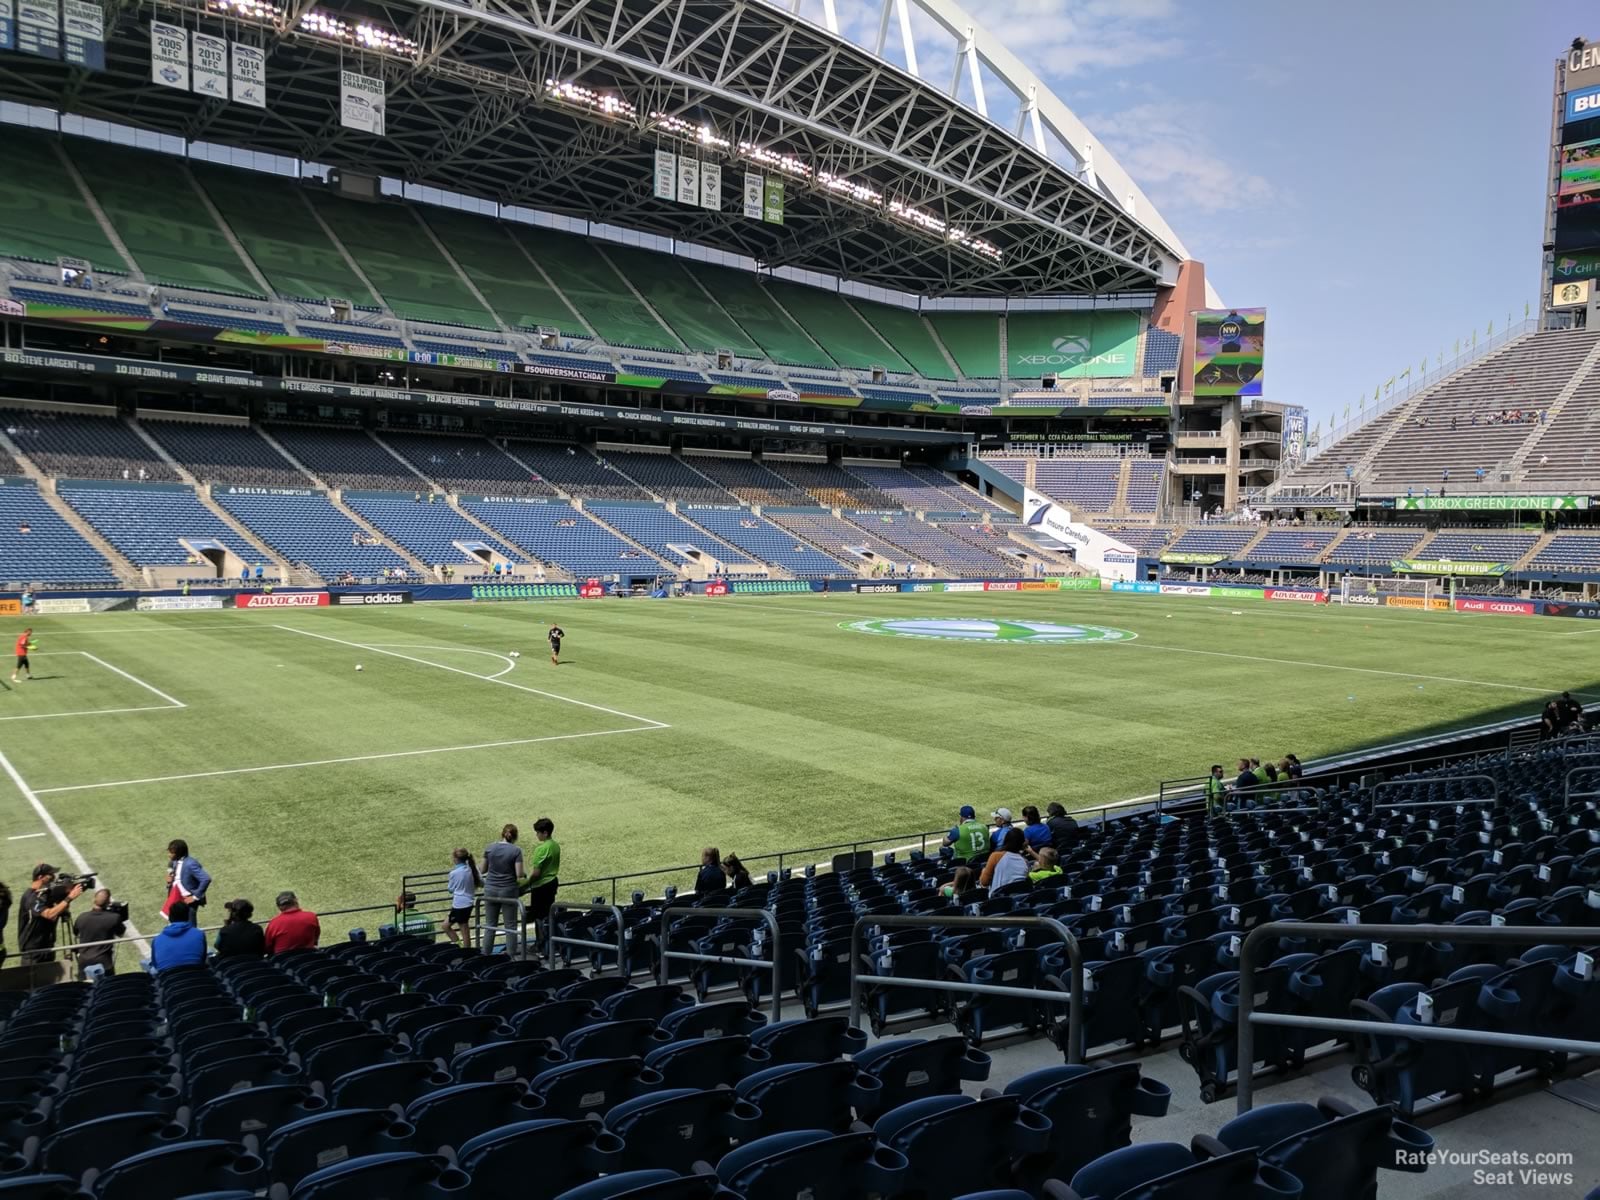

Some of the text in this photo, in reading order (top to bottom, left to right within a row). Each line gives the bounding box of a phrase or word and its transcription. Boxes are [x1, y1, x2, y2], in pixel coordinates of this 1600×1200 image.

[157, 37, 182, 51] 2005
[161, 48, 179, 59] NFC
[198, 48, 222, 62] 2013
[201, 59, 219, 69] NFC
[237, 58, 260, 72] 2014
[240, 68, 257, 79] NFC
[343, 72, 383, 89] 2013 WORLD
[343, 80, 384, 95] CHAMPIONS
[1575, 262, 1592, 274] CHI
[1223, 326, 1237, 334] NW
[20, 355, 44, 367] STEVE
[45, 357, 78, 369] LARGENT
[348, 345, 383, 357] SOUNDERS
[383, 350, 393, 359] FC
[398, 351, 404, 360] 0
[414, 352, 431, 362] 0:00
[442, 355, 448, 363] 0
[454, 357, 483, 368] SPORTING
[483, 360, 493, 369] KC
[1017, 354, 1127, 366] XBOX ONE
[128, 366, 142, 376] JIM
[143, 368, 161, 378] ZORN
[524, 366, 606, 381] #SOUNDERSMATCHDAY
[196, 373, 208, 381] 22
[208, 374, 224, 383] DAVE
[225, 375, 249, 386] BROWN
[287, 381, 301, 391] PETE
[301, 383, 321, 392] GROSS
[360, 388, 375, 397] CURT
[376, 389, 399, 399] WARNER
[436, 395, 452, 404] JACOB
[452, 396, 469, 406] GREEN
[494, 400, 503, 408] 45
[503, 401, 519, 410] KENNY
[520, 403, 537, 412] EASLEY
[682, 417, 697, 425] CORTEZ
[697, 418, 716, 426] KENNEDY
[238, 487, 267, 495] DELTA
[490, 496, 513, 504] DELTA
[1430, 498, 1548, 509] XBOX GREEN ZONE
[1047, 517, 1091, 546] Insure Carefully
[1412, 563, 1437, 571] NORTH
[1438, 564, 1453, 572] END
[874, 585, 897, 593] adidas
[248, 594, 319, 607] ADVOCARE
[365, 593, 403, 604] adidas
[1269, 591, 1316, 601] ADVOCARE
[1349, 594, 1379, 604] adidas
[1464, 602, 1484, 610] Audi
[970, 832, 985, 852] 13
[1359, 1072, 1368, 1084] M
